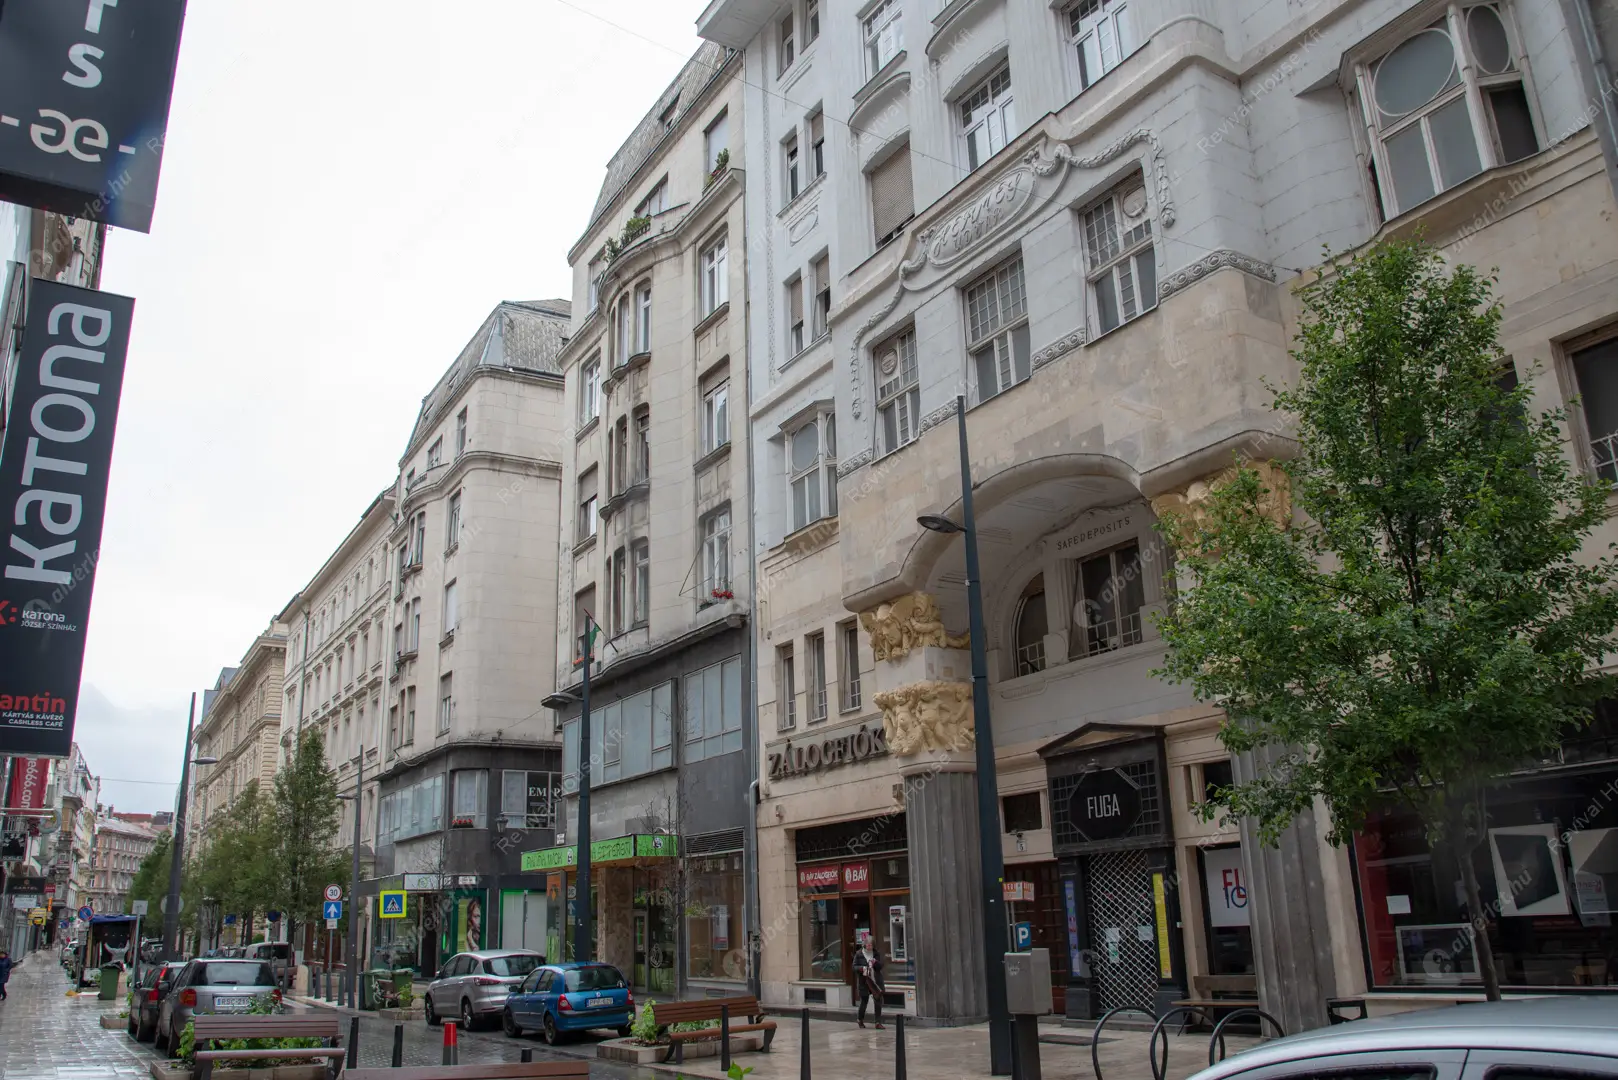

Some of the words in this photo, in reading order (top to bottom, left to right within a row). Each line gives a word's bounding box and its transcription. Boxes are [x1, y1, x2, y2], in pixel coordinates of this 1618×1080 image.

[47, 622, 77, 632] SZÍNHÁZ
[2, 711, 34, 719] KÁRTYÁS
[36, 712, 65, 721] KÁVÉZÓ
[8, 718, 43, 726] CASHLESS
[45, 719, 63, 727] CAFÉ
[768, 724, 886, 779] ZÁLOGFIÓK
[1087, 793, 1121, 820] FUGA
[852, 866, 868, 882] BÁV
[329, 889, 338, 897] 30
[1018, 927, 1029, 944] P
